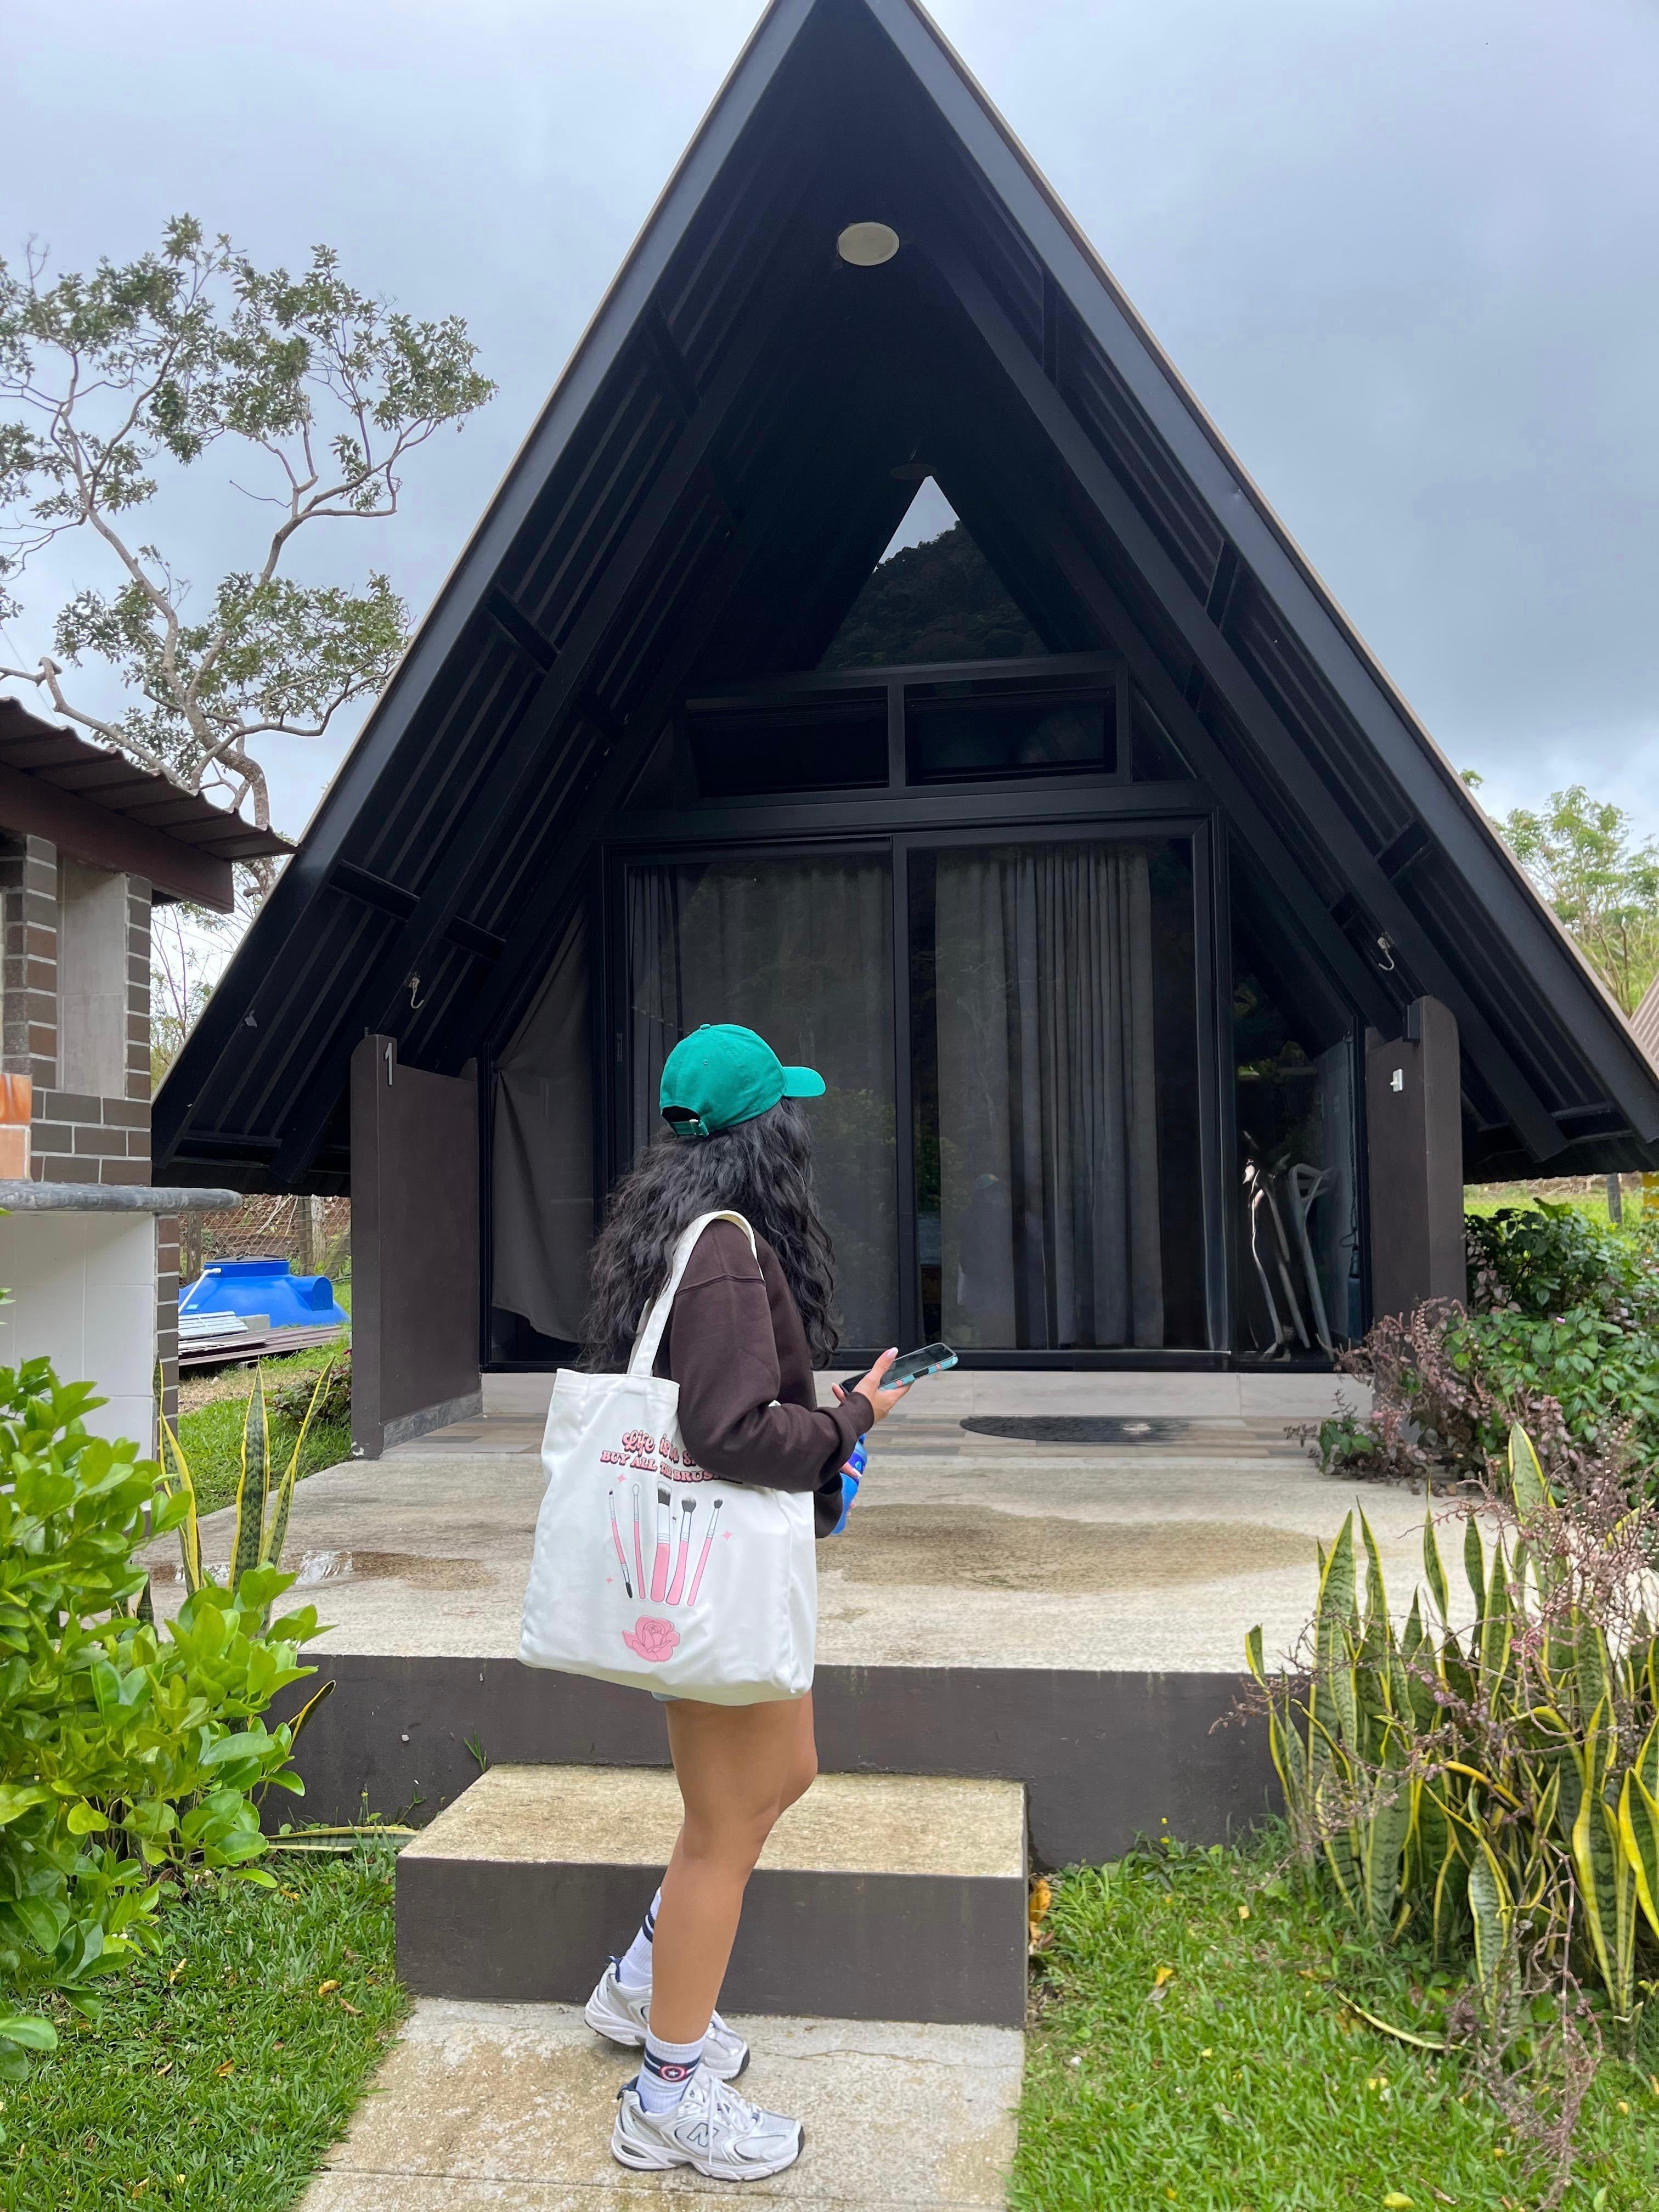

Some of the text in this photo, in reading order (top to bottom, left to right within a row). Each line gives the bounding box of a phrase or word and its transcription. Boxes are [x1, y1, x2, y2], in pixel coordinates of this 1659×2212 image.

[384, 1042, 393, 1086] 1
[622, 1430, 655, 1457] Life
[659, 1434, 672, 1458] is
[600, 1450, 630, 1465] BUY
[630, 1457, 658, 1472] ALL
